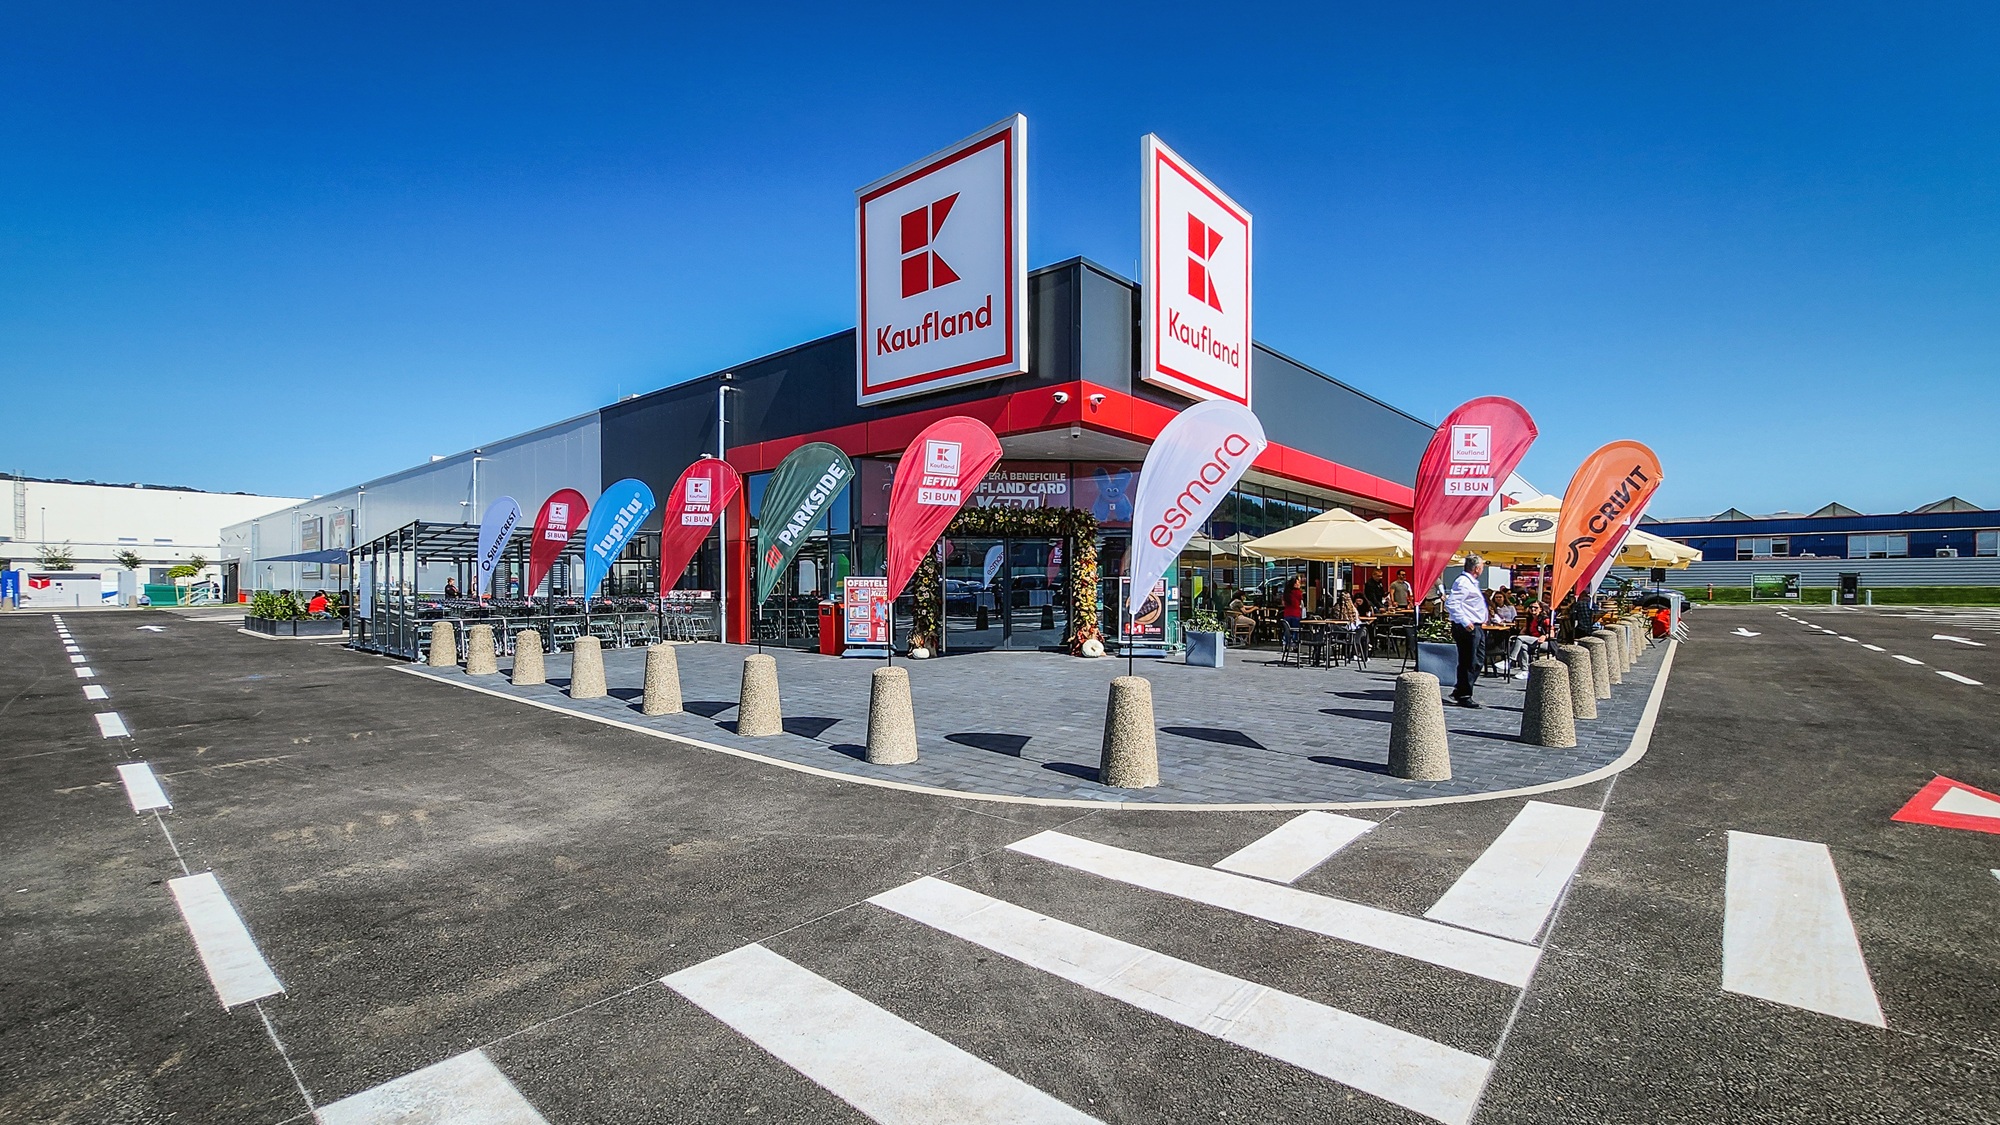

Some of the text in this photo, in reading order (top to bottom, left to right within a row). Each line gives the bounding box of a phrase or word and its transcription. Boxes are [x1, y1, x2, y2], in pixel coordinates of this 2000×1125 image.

[877, 294, 992, 356] Kaufland
[1169, 307, 1239, 368] Kaufland
[922, 476, 958, 487] IEFTIN
[1010, 472, 1066, 480] BENEFICIILE
[1028, 483, 1066, 494] CARD
[1150, 433, 1250, 548] esmara
[1449, 465, 1490, 475] IEFTIN
[1450, 482, 1489, 493] ȘI BUN
[779, 462, 846, 546] PARKSIDE
[922, 491, 957, 502] ȘI BUN
[1589, 465, 1648, 533] CRIVIT
[487, 510, 516, 561] SILVERCREST
[593, 498, 642, 558] lupilu
